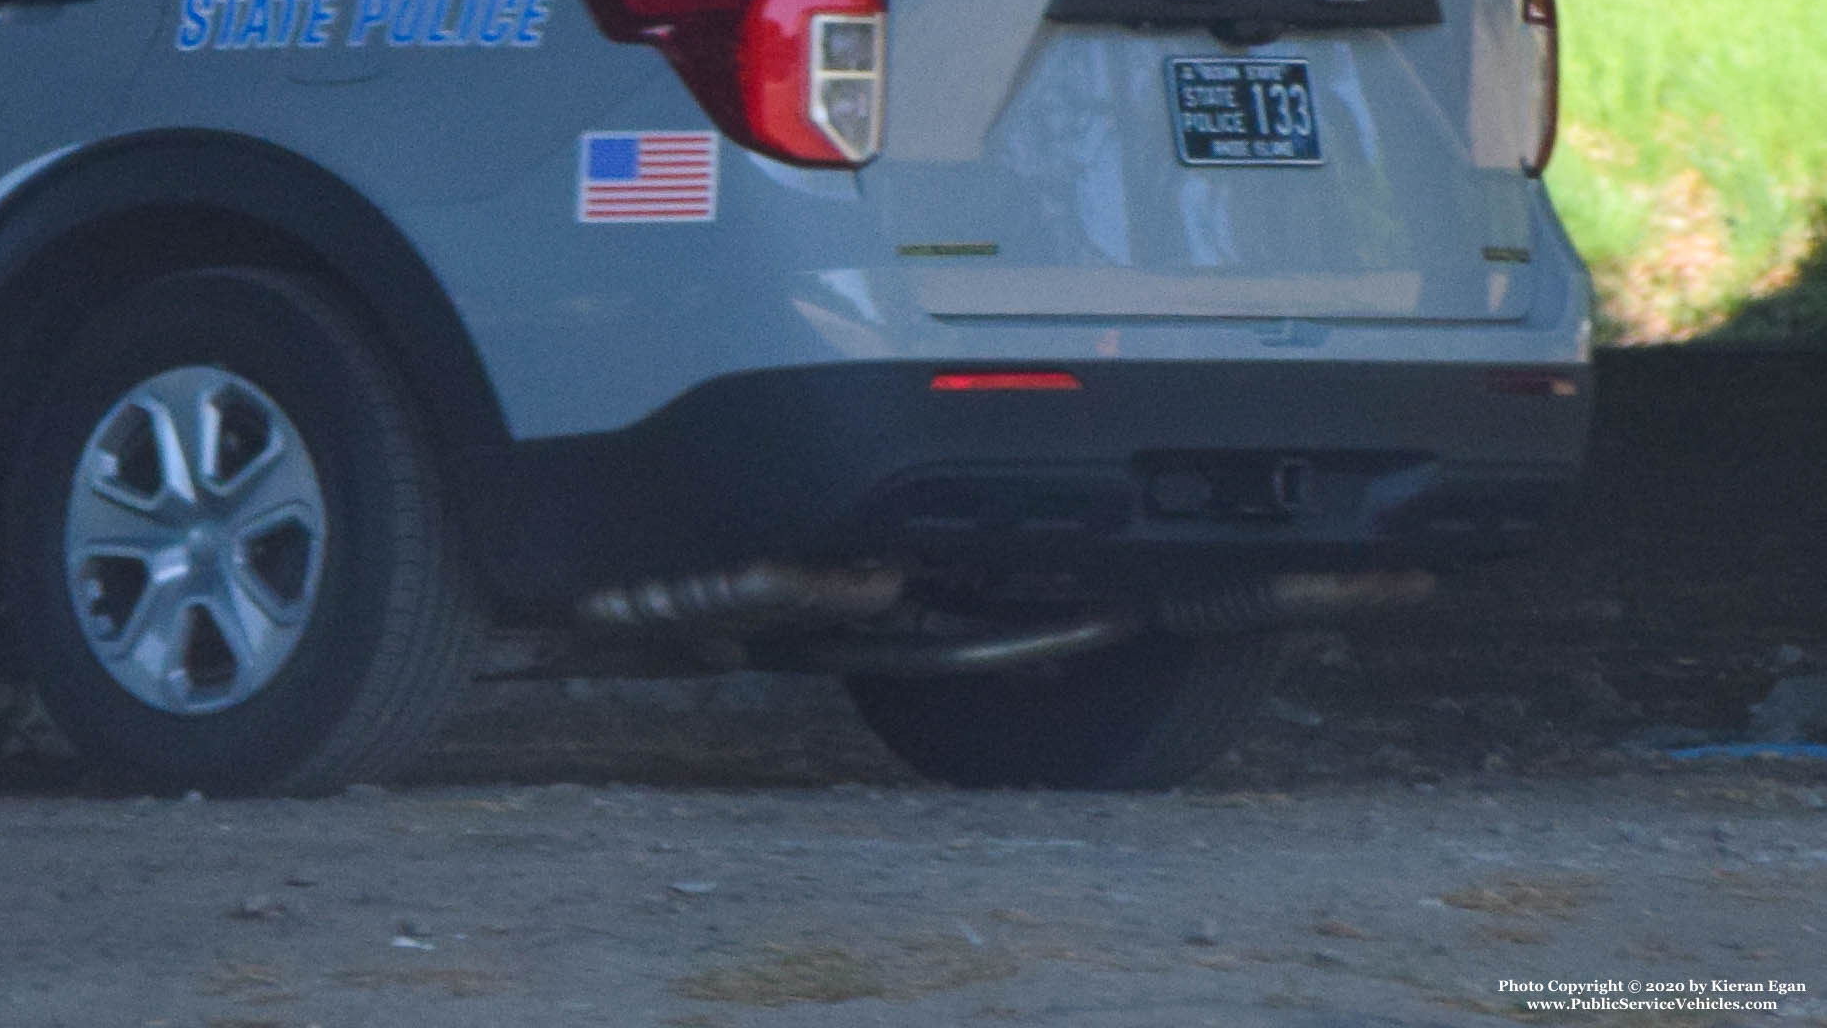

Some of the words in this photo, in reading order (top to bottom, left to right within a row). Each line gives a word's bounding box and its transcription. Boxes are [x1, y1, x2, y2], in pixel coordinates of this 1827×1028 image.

[1181, 85, 1240, 108] STATE
[1252, 83, 1312, 137] 133
[1182, 111, 1248, 133] POLICE
